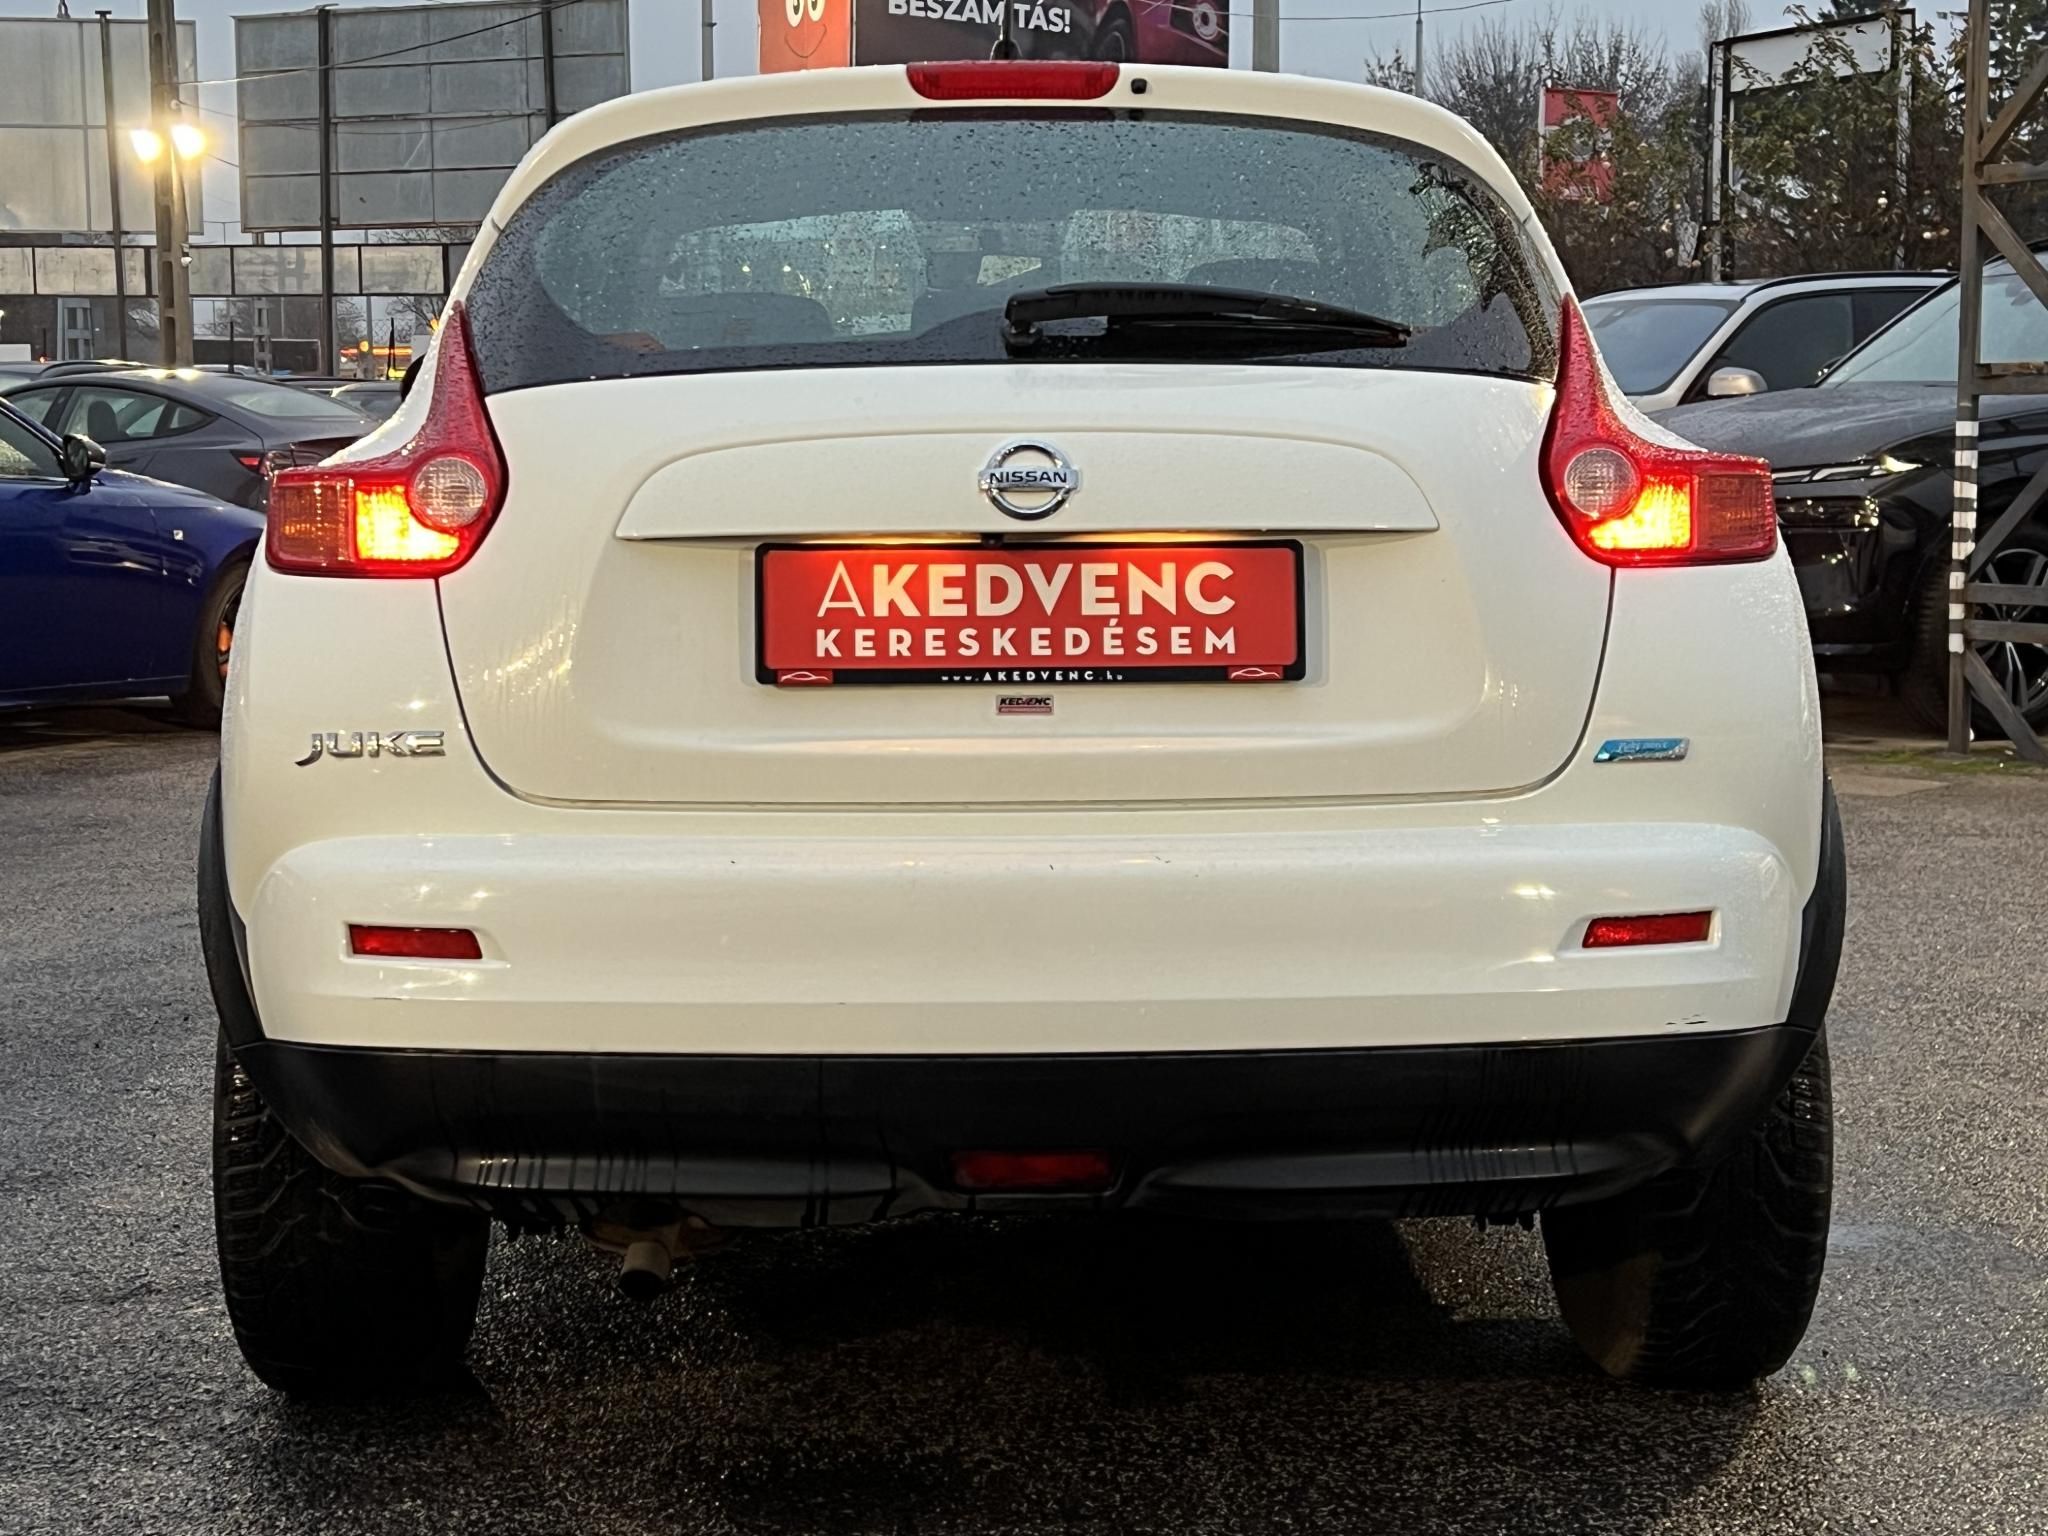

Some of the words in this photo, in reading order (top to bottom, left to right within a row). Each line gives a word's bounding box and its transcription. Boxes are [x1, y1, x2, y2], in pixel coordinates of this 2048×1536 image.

[989, 471, 1067, 483] NISSAN
[816, 618, 1236, 658] KERESKEDÉSEM
[294, 730, 446, 767] JUKE
